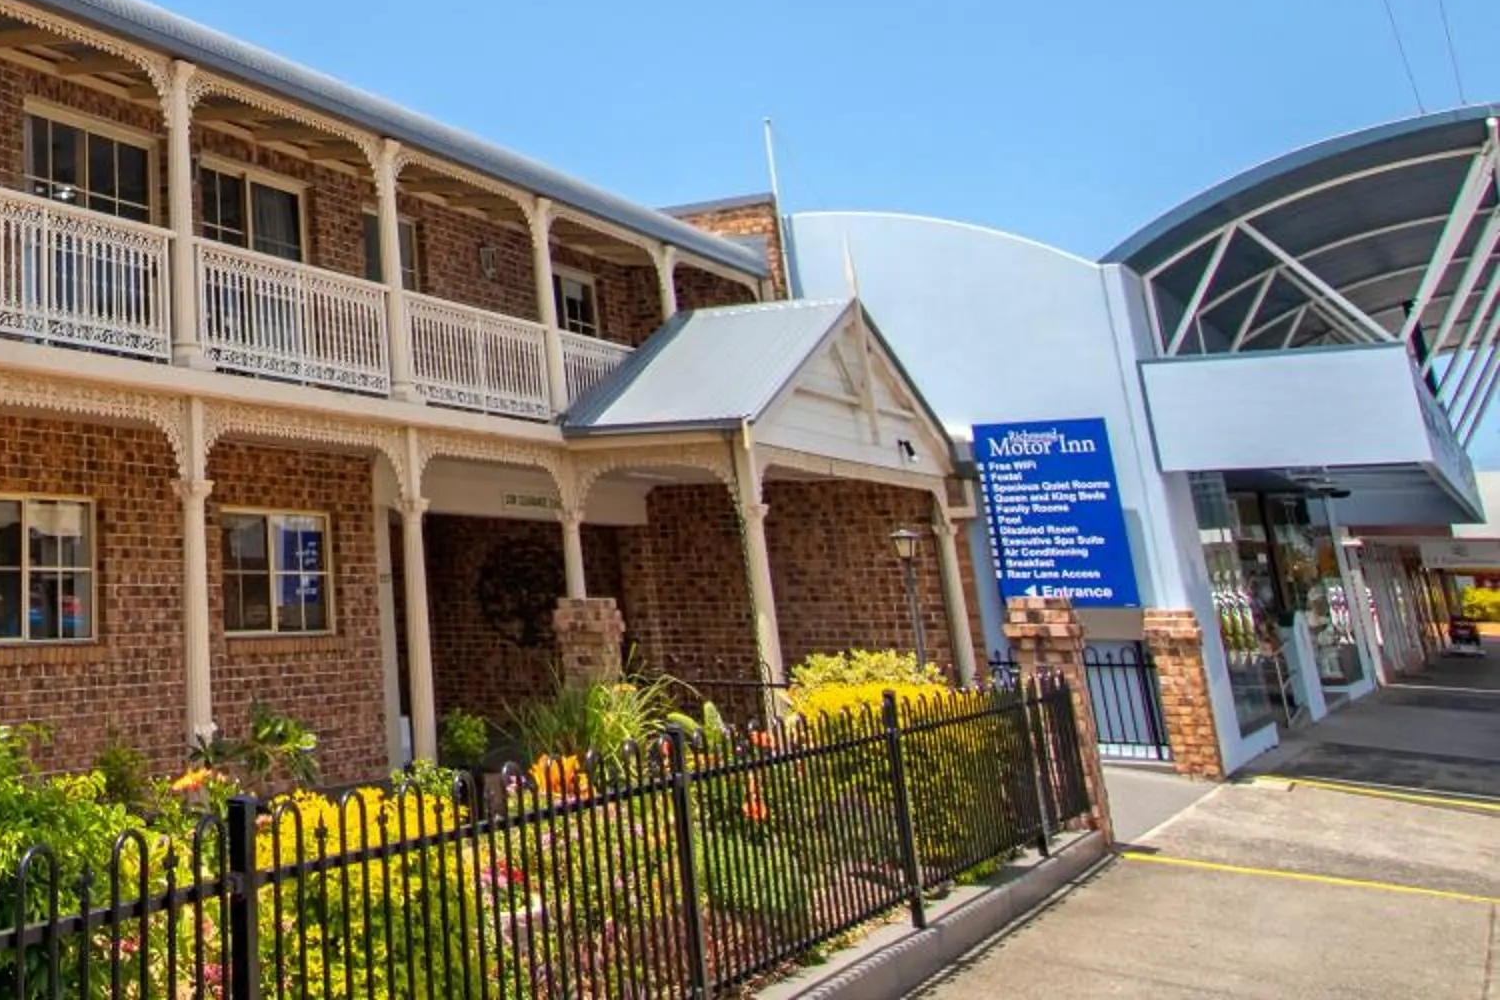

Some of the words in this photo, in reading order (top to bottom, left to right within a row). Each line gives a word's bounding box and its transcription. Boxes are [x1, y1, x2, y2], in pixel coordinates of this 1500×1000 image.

[987, 436, 1052, 457] Motor
[1058, 434, 1096, 453] Inn
[989, 461, 1012, 471] Free
[990, 472, 1022, 481] Foxtel
[993, 483, 1039, 493] Spacious
[1041, 481, 1070, 491] Quiet
[1071, 480, 1110, 489] Rooms
[994, 494, 1028, 503] Queen
[1030, 492, 1049, 501] and
[1051, 491, 1077, 503] King
[1078, 491, 1106, 501] Beds
[995, 504, 1030, 514] Family
[1031, 503, 1070, 512] Rooms
[997, 515, 1022, 524] Pool
[1000, 525, 1045, 535] Disabled
[1046, 525, 1079, 534] Room
[1001, 537, 1052, 546] Executive
[1054, 536, 1075, 546] Spa
[1003, 548, 1018, 557] Air
[1021, 548, 1089, 558] Conditioning
[1005, 559, 1055, 568] Breakfast
[1007, 570, 1032, 579] Rear
[1034, 570, 1060, 579] Lane
[1061, 569, 1101, 578] Access
[1042, 585, 1113, 599] Entrance
